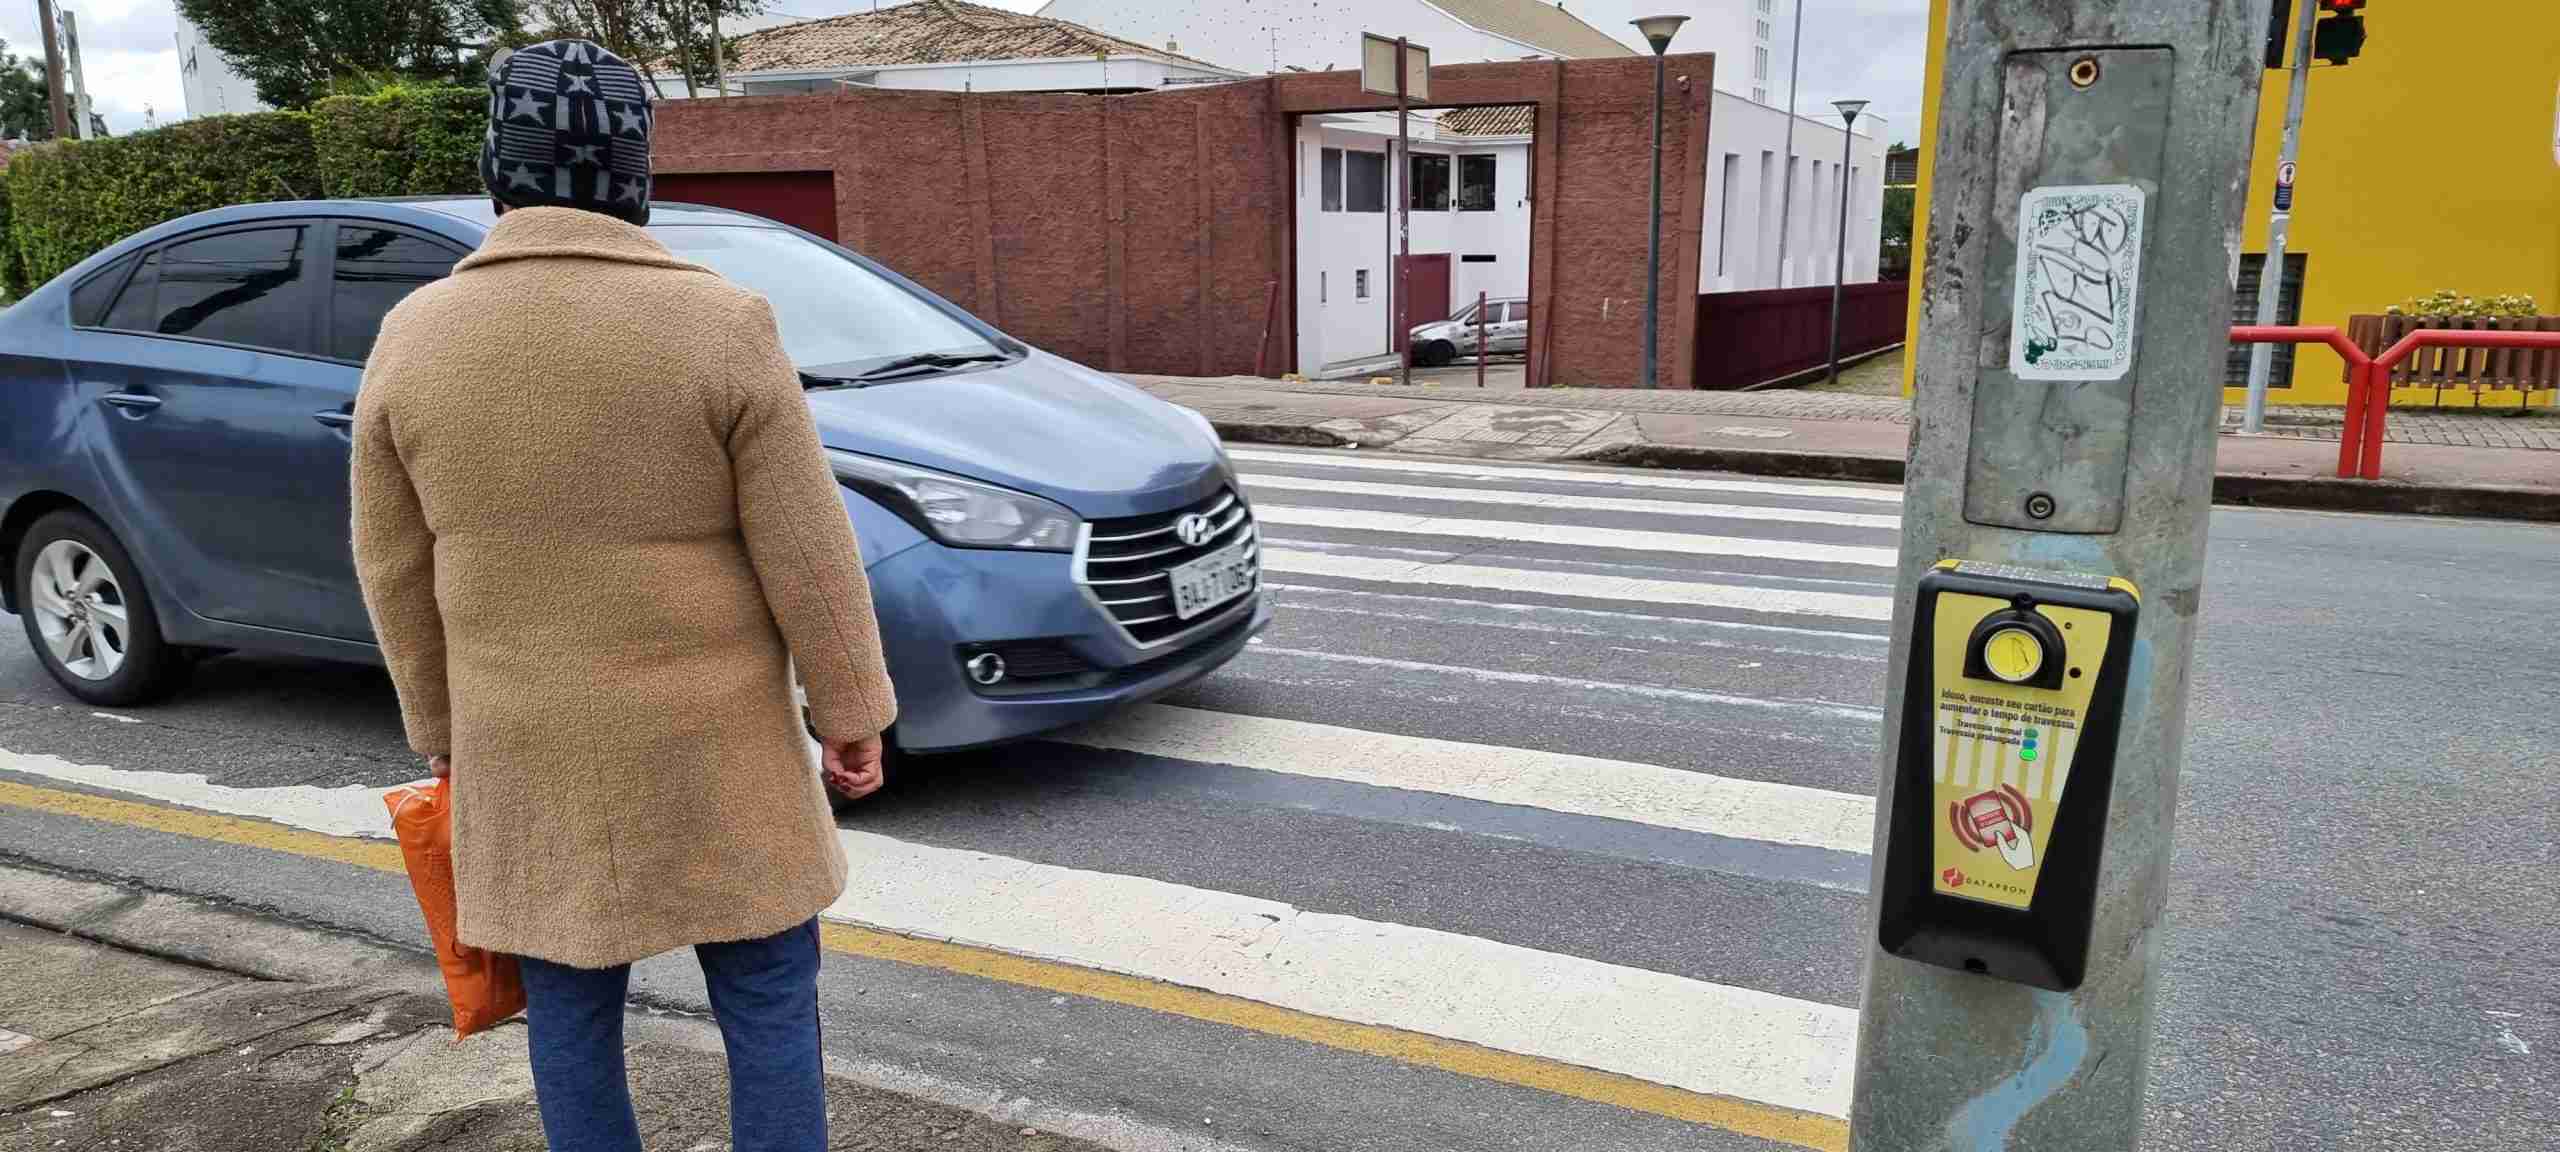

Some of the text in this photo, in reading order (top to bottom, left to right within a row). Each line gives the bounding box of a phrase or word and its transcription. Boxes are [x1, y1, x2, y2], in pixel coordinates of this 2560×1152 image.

[1940, 703, 1981, 715] aumentar
[1991, 708, 2019, 721] tempo
[2021, 712, 2032, 723] de
[1969, 694, 2004, 706] encoste
[2006, 699, 2021, 709] seu
[2024, 701, 2053, 714] cartão
[2055, 706, 2075, 717] para
[1940, 726, 2020, 745] Travessia prolongada
[1958, 719, 2022, 736] Travessia normal
